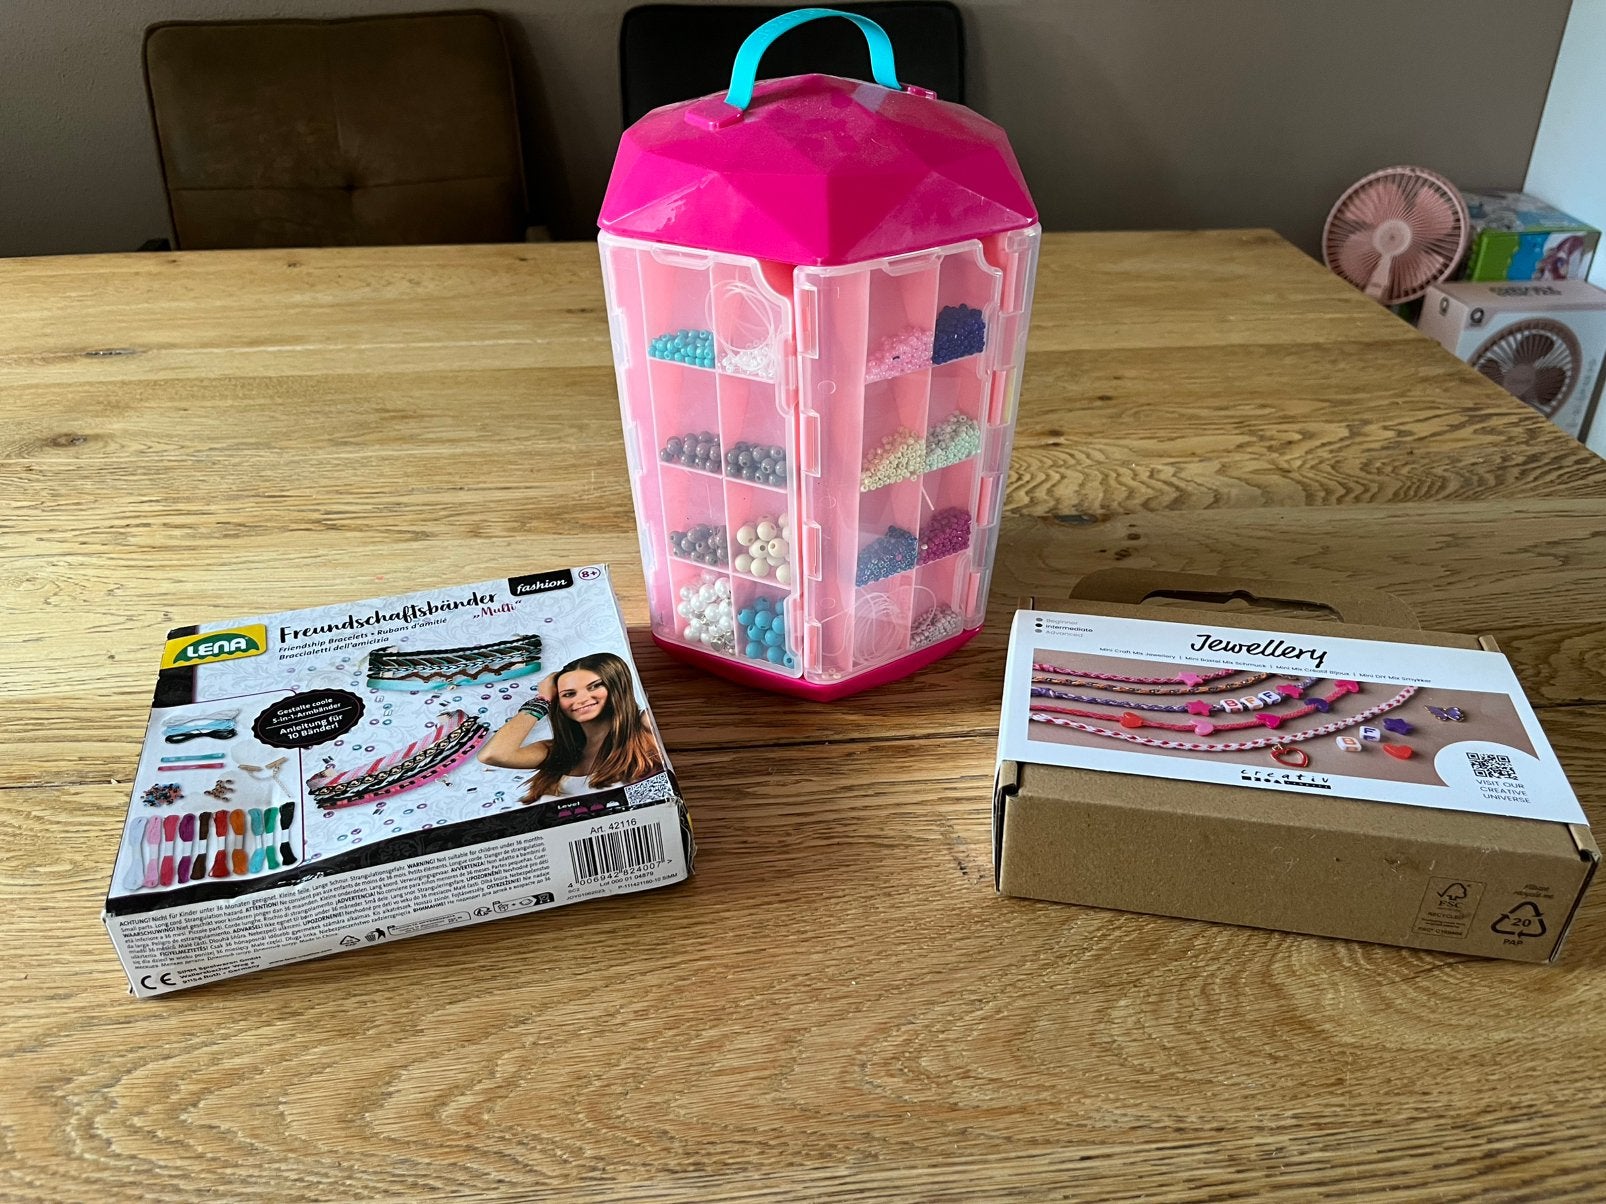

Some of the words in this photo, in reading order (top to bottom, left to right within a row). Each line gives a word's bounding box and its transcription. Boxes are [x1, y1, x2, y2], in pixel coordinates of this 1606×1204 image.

[516, 577, 567, 595] fashion
[581, 569, 598, 579] 8+
[279, 591, 497, 644] Freundschaftsbänder
[279, 640, 326, 652] Friendship
[328, 632, 369, 645] Bracelets
[377, 625, 410, 636] Rubans
[411, 617, 447, 629] d'amitié
[186, 637, 247, 658] LENA
[279, 647, 331, 661] Braccialetti
[333, 636, 389, 650] dell'amicizia
[1190, 633, 1328, 668] Jewellery
[1235, 660, 1267, 668] Schmuck
[272, 702, 341, 724] 5-in-1-Armbänder
[277, 704, 311, 716] Gestalte
[312, 697, 333, 708] coole
[279, 717, 327, 735] Anleitung
[328, 714, 343, 724] für
[288, 731, 299, 740] 10
[301, 722, 339, 737] Bänder!
[1480, 786, 1528, 796] CREATIVE
[1482, 793, 1531, 804] UNIVERSE
[557, 801, 580, 810] Level
[590, 826, 606, 835] Art.
[608, 818, 637, 831] 42116
[580, 871, 619, 886] 006942
[623, 861, 662, 875] 824007
[1438, 900, 1464, 909] FSC
[1511, 917, 1532, 927] 20
[1503, 938, 1524, 946] PAP
